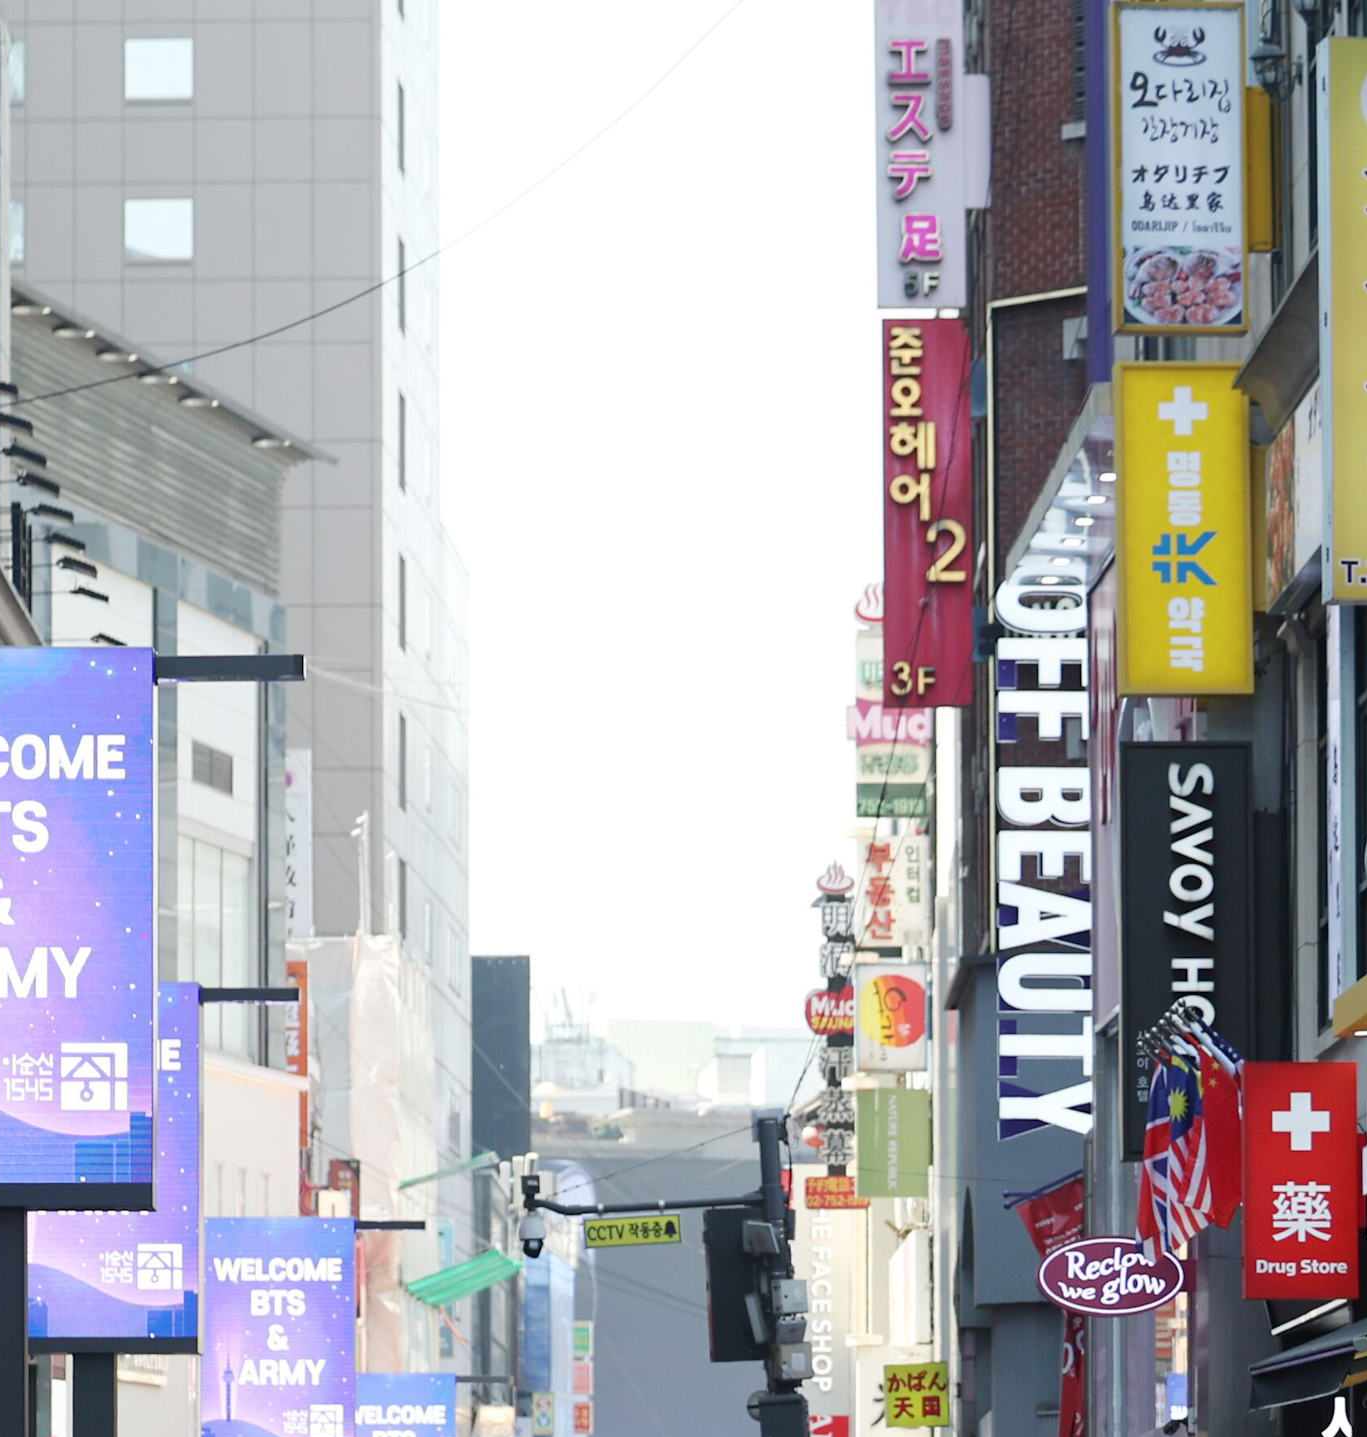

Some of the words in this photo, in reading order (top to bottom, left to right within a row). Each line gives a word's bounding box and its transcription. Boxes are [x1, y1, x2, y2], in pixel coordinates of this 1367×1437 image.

[890, 661, 937, 697] 3F
[1164, 762, 1215, 942] SAVOY
[997, 766, 1093, 1136] BEAUTY
[3, 1078, 54, 1101] 1545
[811, 1208, 832, 1240] HE
[1271, 1181, 1333, 1244] 藥
[587, 1224, 624, 1242] CCTV
[213, 1257, 343, 1283] WELCOME
[811, 1245, 832, 1314] FACE
[1255, 1257, 1296, 1278] Drug
[1300, 1257, 1349, 1275] Store
[1057, 1281, 1097, 1301] we
[1100, 1268, 1167, 1305] glow
[250, 1289, 306, 1317] BTS
[266, 1324, 289, 1351] &
[811, 1318, 833, 1392] SHOP
[238, 1359, 326, 1386] ARMY
[887, 1371, 947, 1393] かばん
[893, 1396, 941, 1419] 天国
